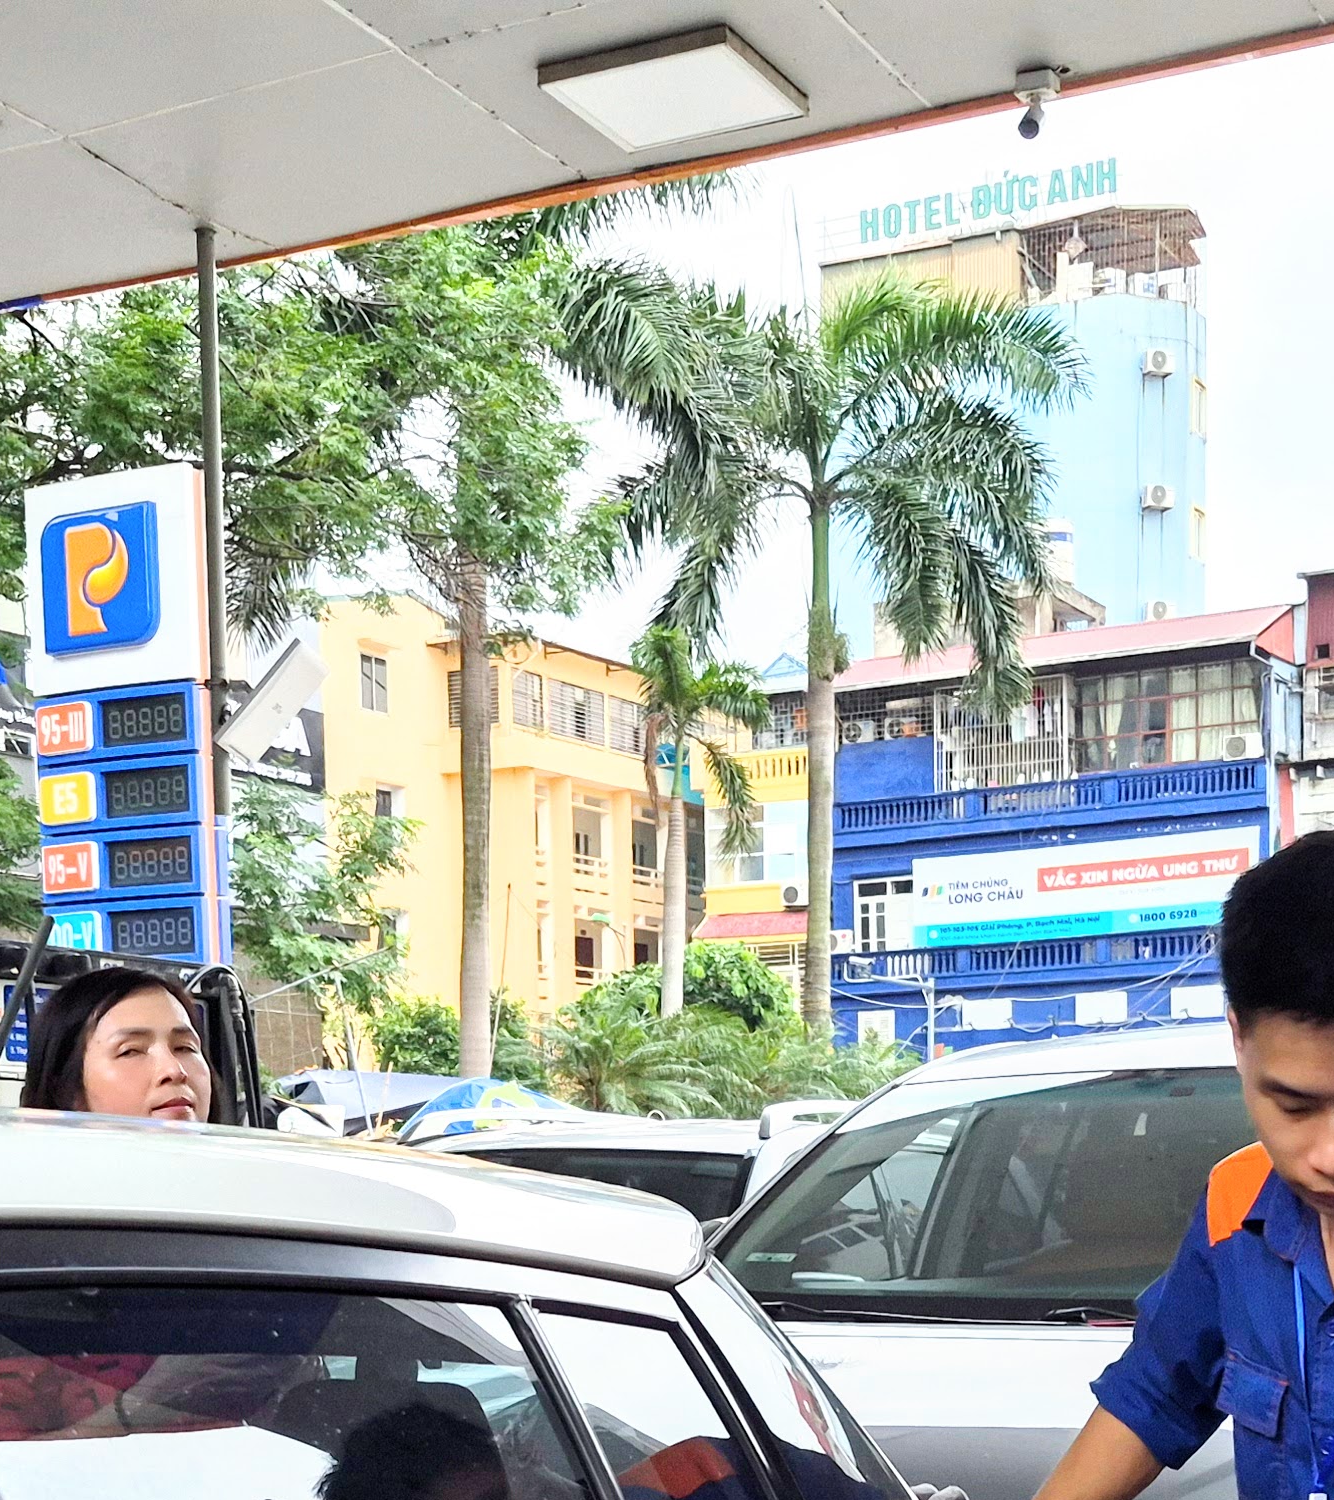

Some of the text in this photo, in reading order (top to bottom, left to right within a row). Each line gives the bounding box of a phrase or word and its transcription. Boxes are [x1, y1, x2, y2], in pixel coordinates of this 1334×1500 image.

[859, 157, 1118, 244] HOTEL ĐỨC ANH
[41, 710, 85, 747] 95-III
[52, 781, 79, 815] E5
[48, 851, 88, 886] 95-V
[1080, 868, 1109, 885] XIN
[1163, 861, 1199, 877] UNG
[1202, 855, 1239, 873] THƯ
[948, 892, 984, 905] LONG
[987, 887, 1024, 901] CHÂU
[1139, 912, 1166, 923] 1800
[1169, 909, 1198, 920] 6928
